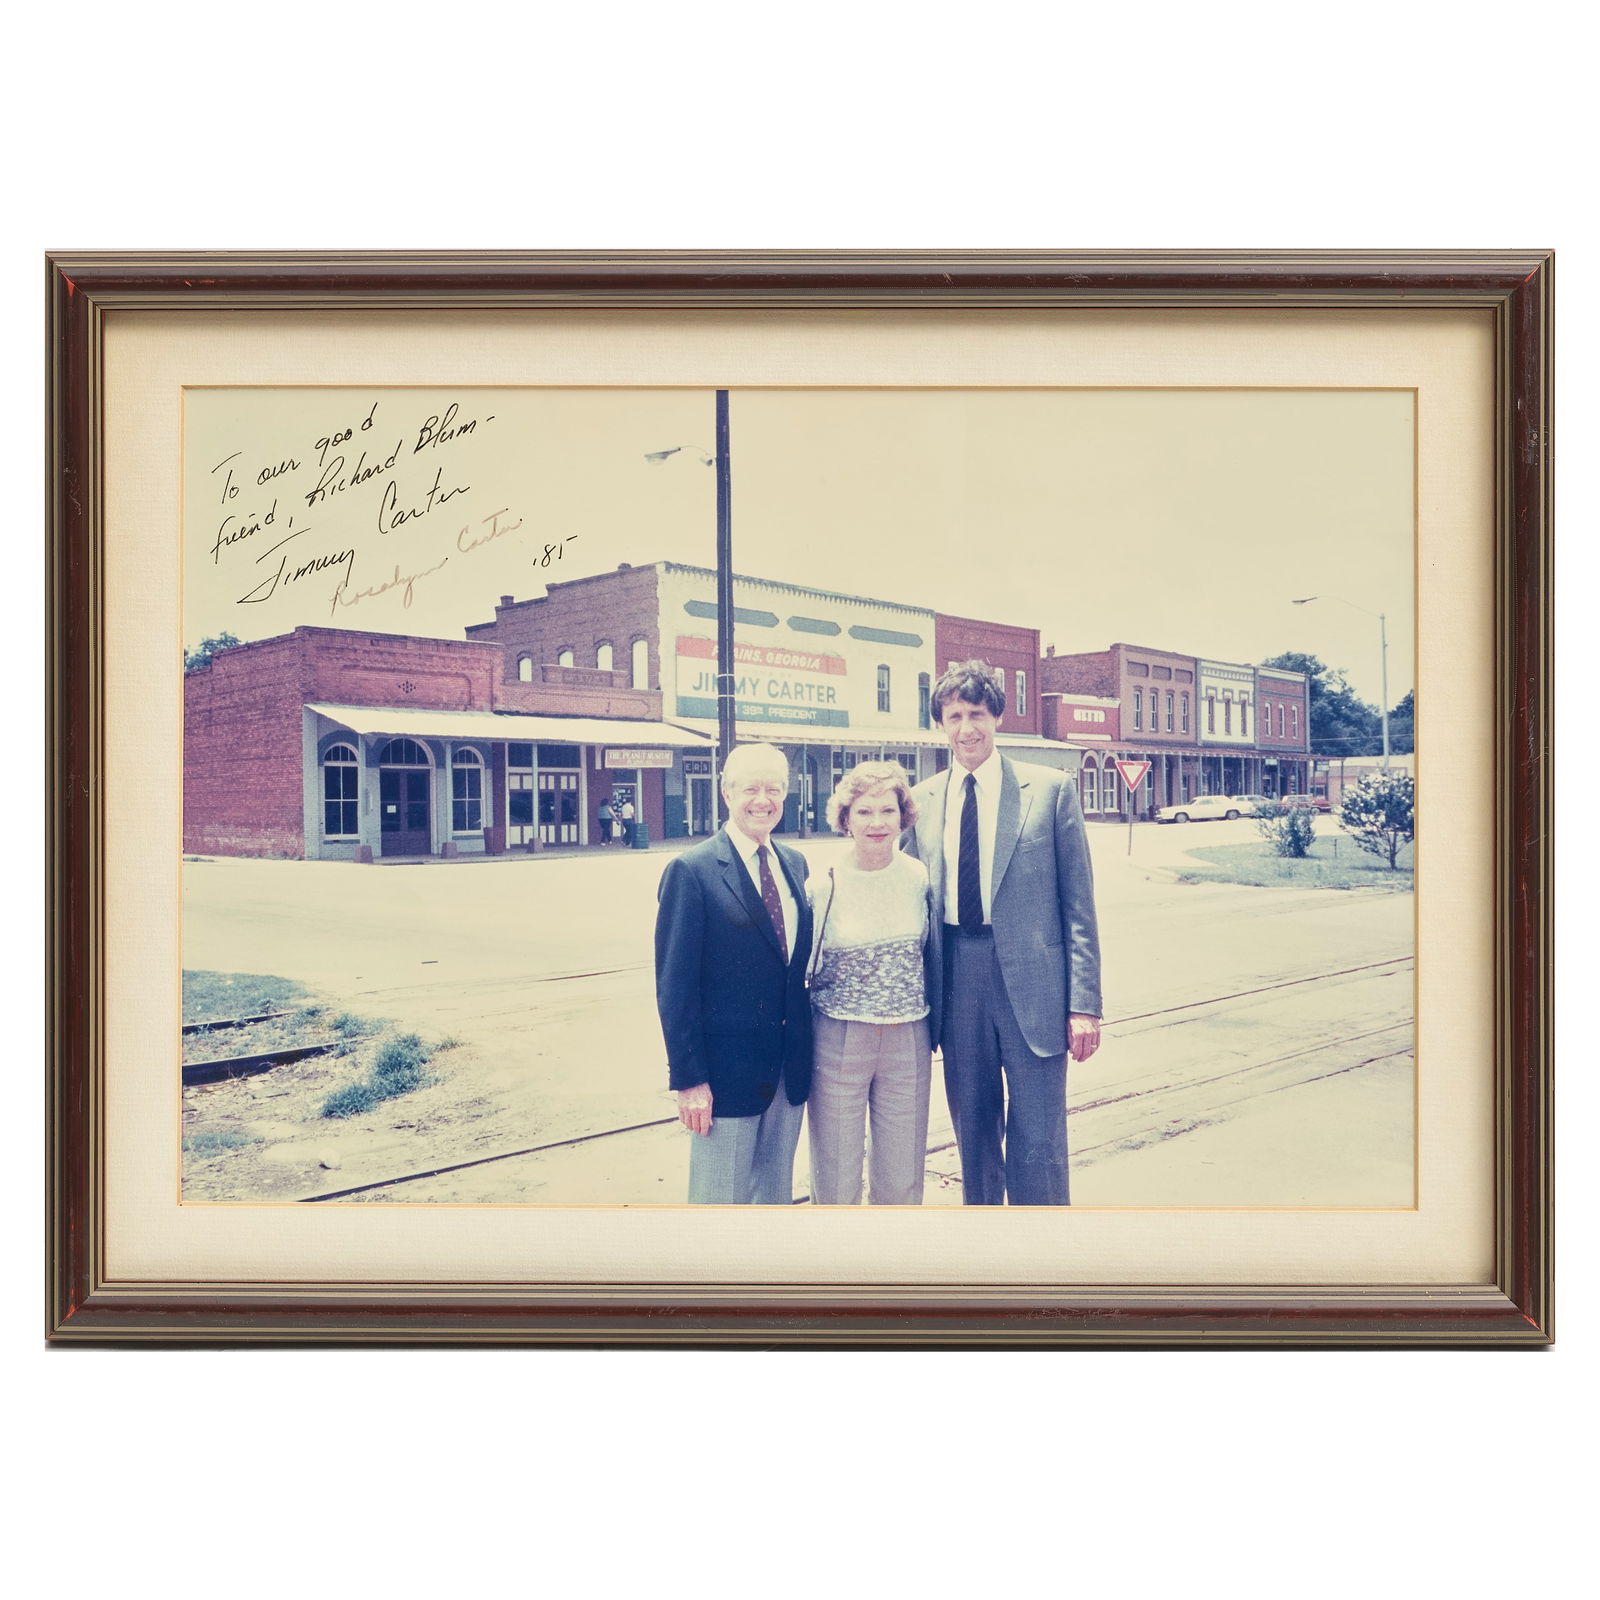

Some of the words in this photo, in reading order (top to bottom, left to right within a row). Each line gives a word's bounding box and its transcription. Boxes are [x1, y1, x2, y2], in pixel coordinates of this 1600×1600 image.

[211, 451, 240, 505] To
[256, 458, 302, 486] our
[314, 401, 379, 468] good
[303, 438, 403, 509] Richard
[235, 527, 355, 605] Jimmy
[378, 466, 471, 535] Carter
[765, 650, 823, 671] GEORGIA
[767, 678, 837, 705] CARTER
[768, 706, 818, 721] PRESIDENT
